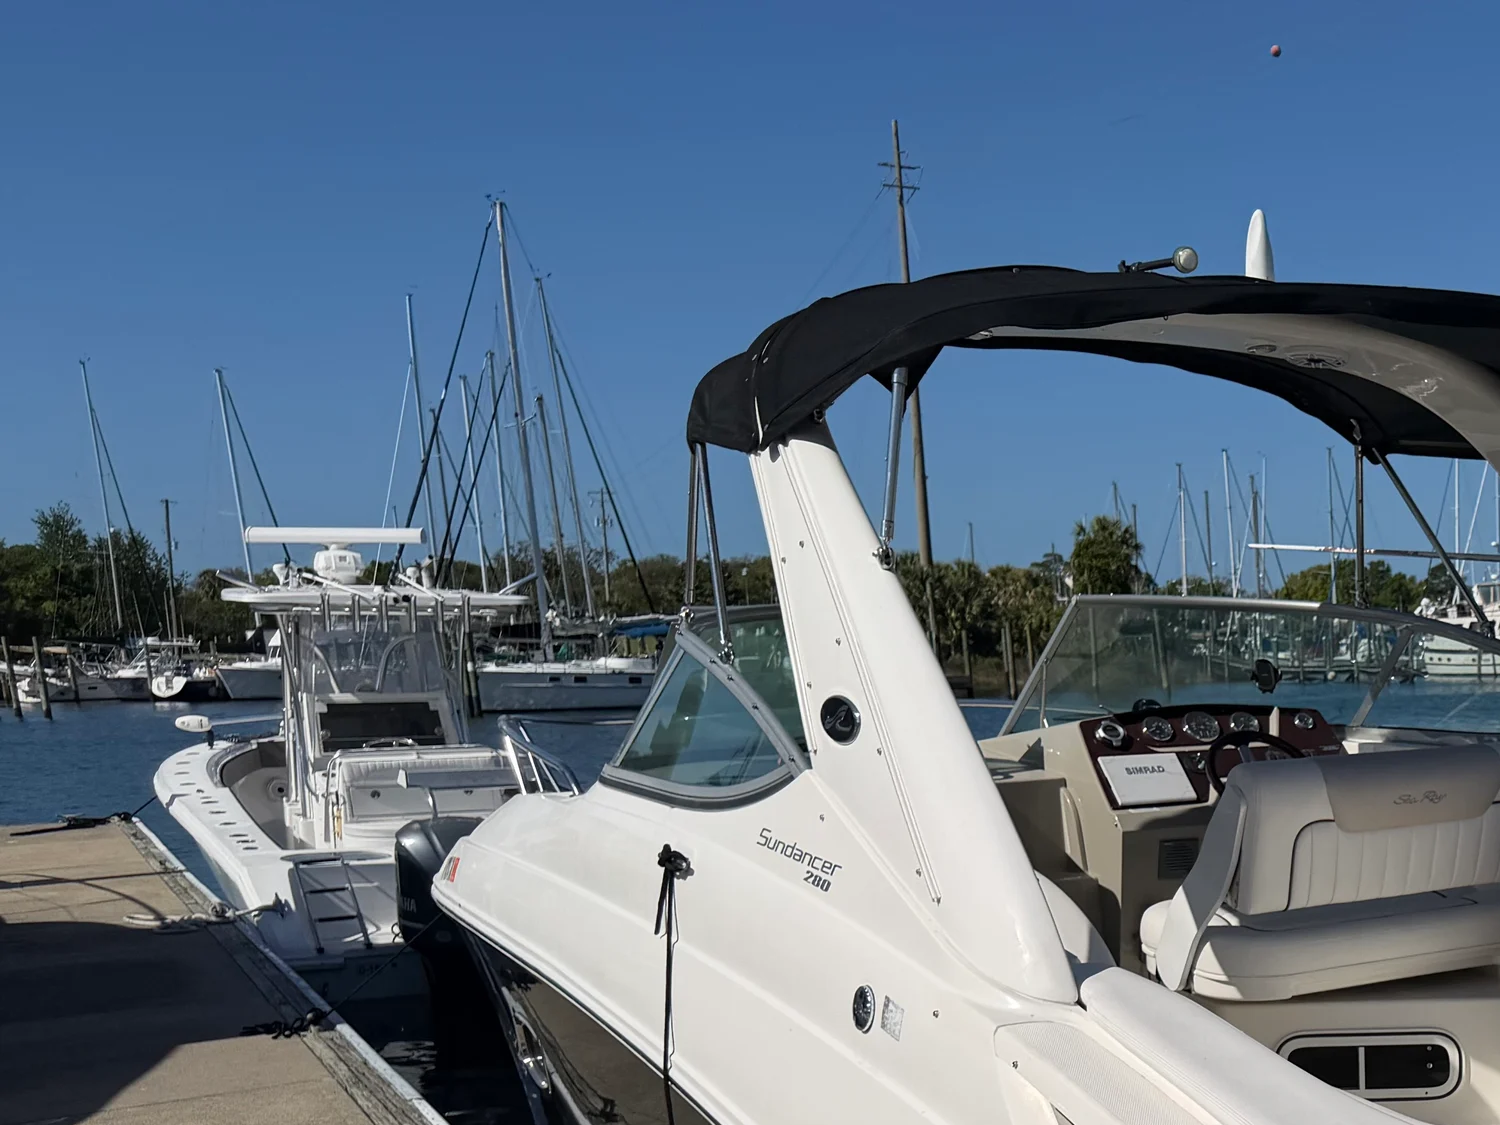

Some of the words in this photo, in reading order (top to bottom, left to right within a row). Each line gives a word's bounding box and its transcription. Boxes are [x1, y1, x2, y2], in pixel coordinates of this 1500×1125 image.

[1125, 765, 1165, 775] SIMRAD
[1393, 794, 1419, 805] Sea
[1420, 790, 1447, 804] Ray
[756, 827, 843, 876] Sundancer
[803, 870, 832, 892] 280
